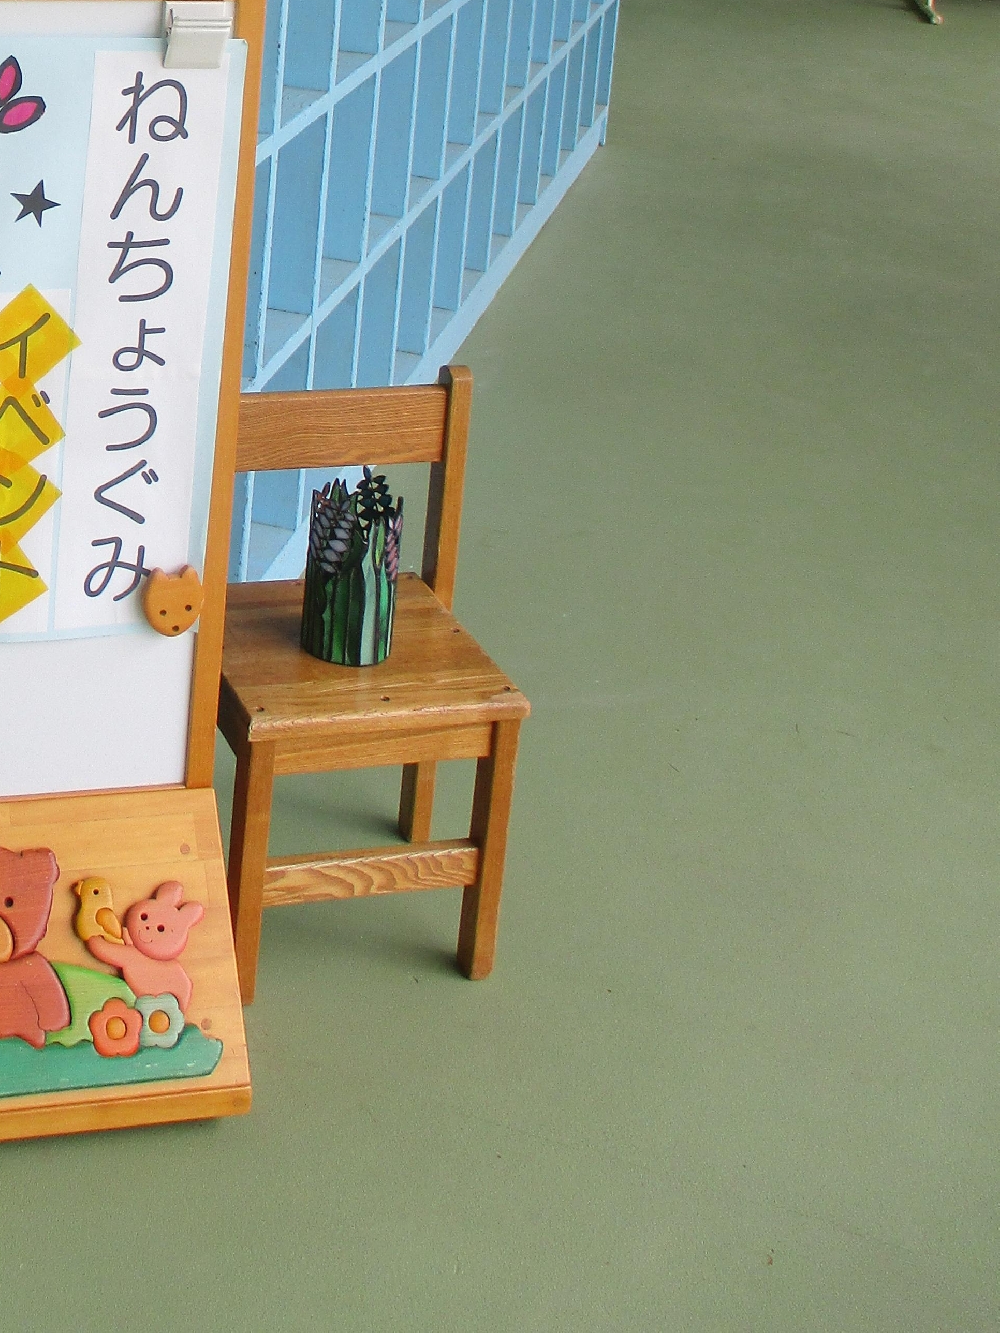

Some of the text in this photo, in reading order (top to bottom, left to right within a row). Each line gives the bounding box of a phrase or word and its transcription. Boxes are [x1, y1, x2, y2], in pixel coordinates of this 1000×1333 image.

[83, 71, 189, 602] ねんちょうぐみ
